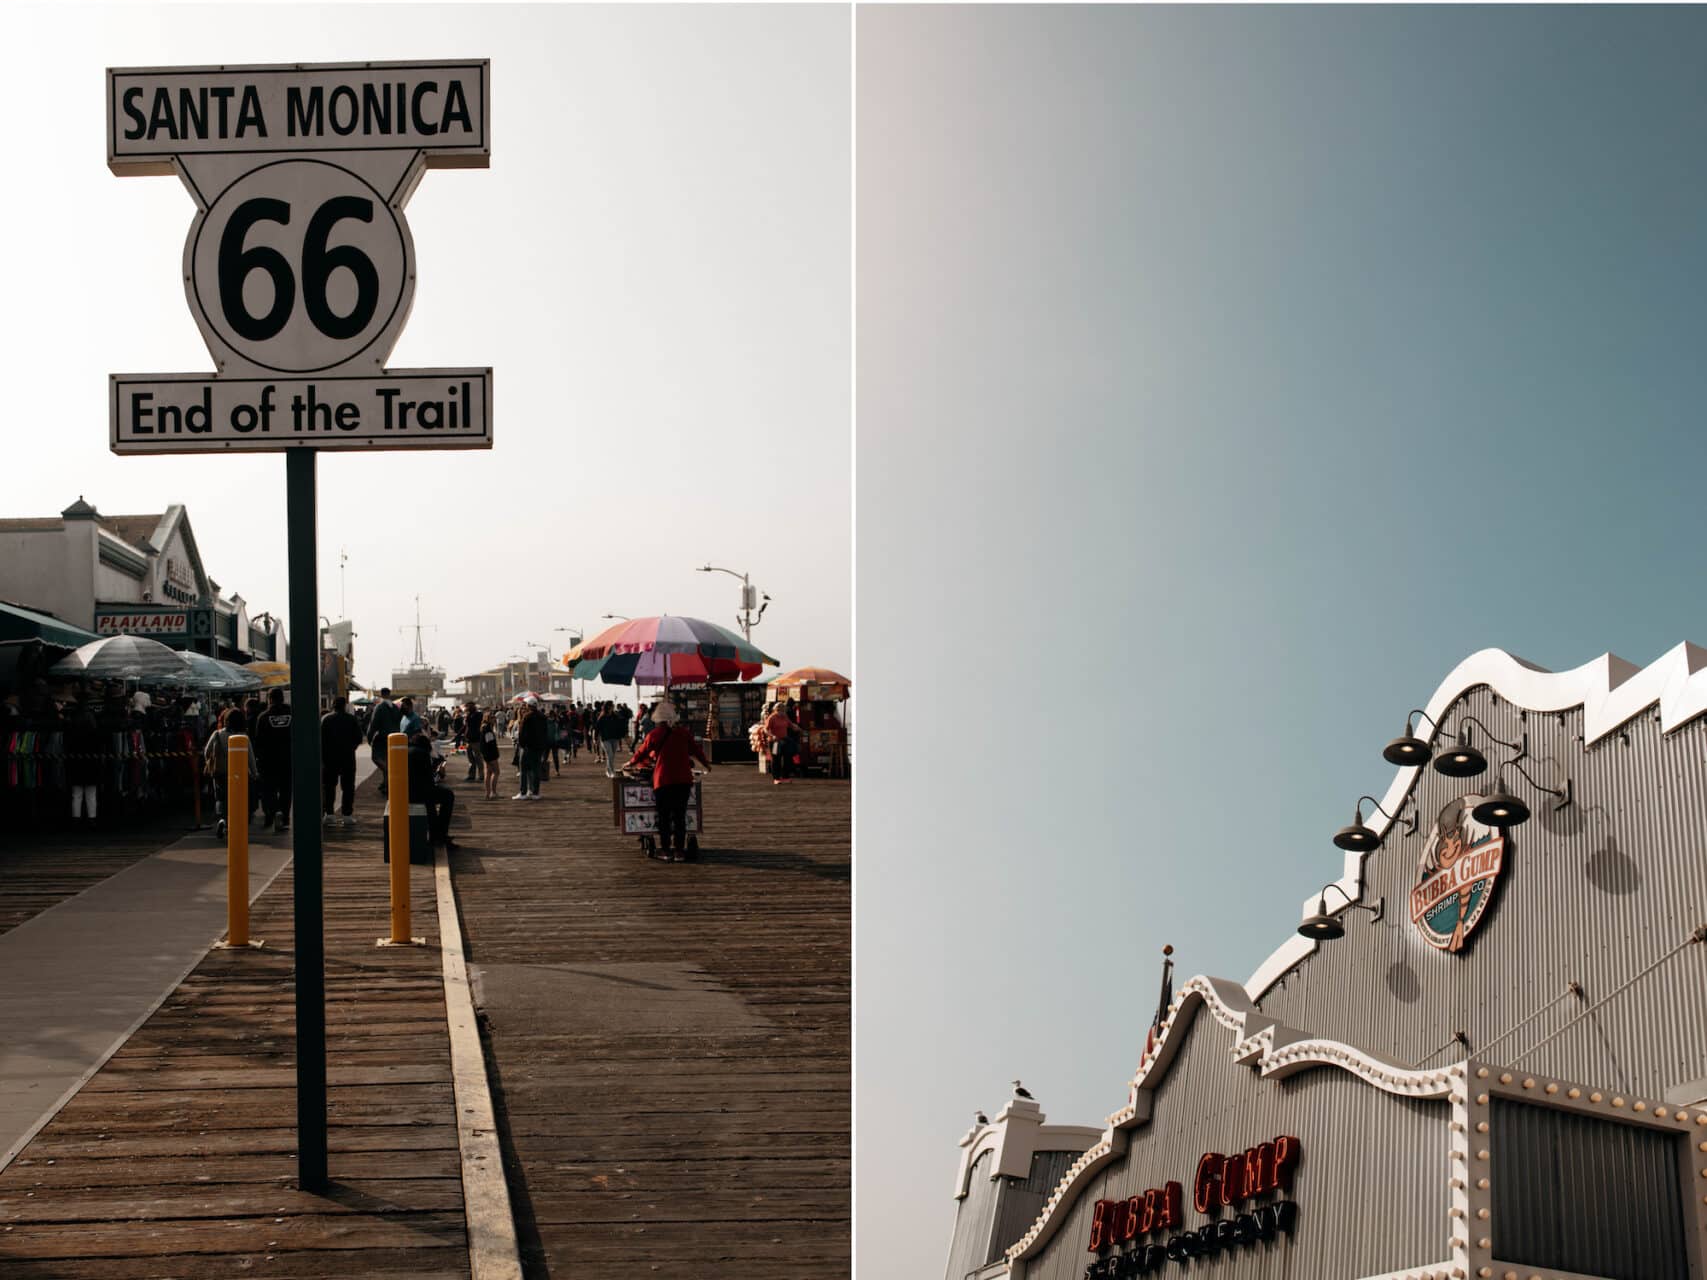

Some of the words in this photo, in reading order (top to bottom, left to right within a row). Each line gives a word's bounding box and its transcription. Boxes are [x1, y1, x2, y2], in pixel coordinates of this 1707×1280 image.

[121, 84, 268, 140] SANTA
[286, 79, 474, 138] MONICA
[217, 194, 380, 342] 66
[130, 386, 214, 435] End
[230, 385, 276, 433] of
[291, 384, 361, 431] the
[375, 381, 472, 430] Trail
[100, 615, 185, 628] PLAYLAND
[1414, 866, 1458, 916] BUBBA
[1460, 847, 1501, 882] GUMP
[1426, 892, 1459, 921] SHRIMP
[1087, 1180, 1182, 1253] BUBBA
[1194, 1135, 1300, 1214] GUMP
